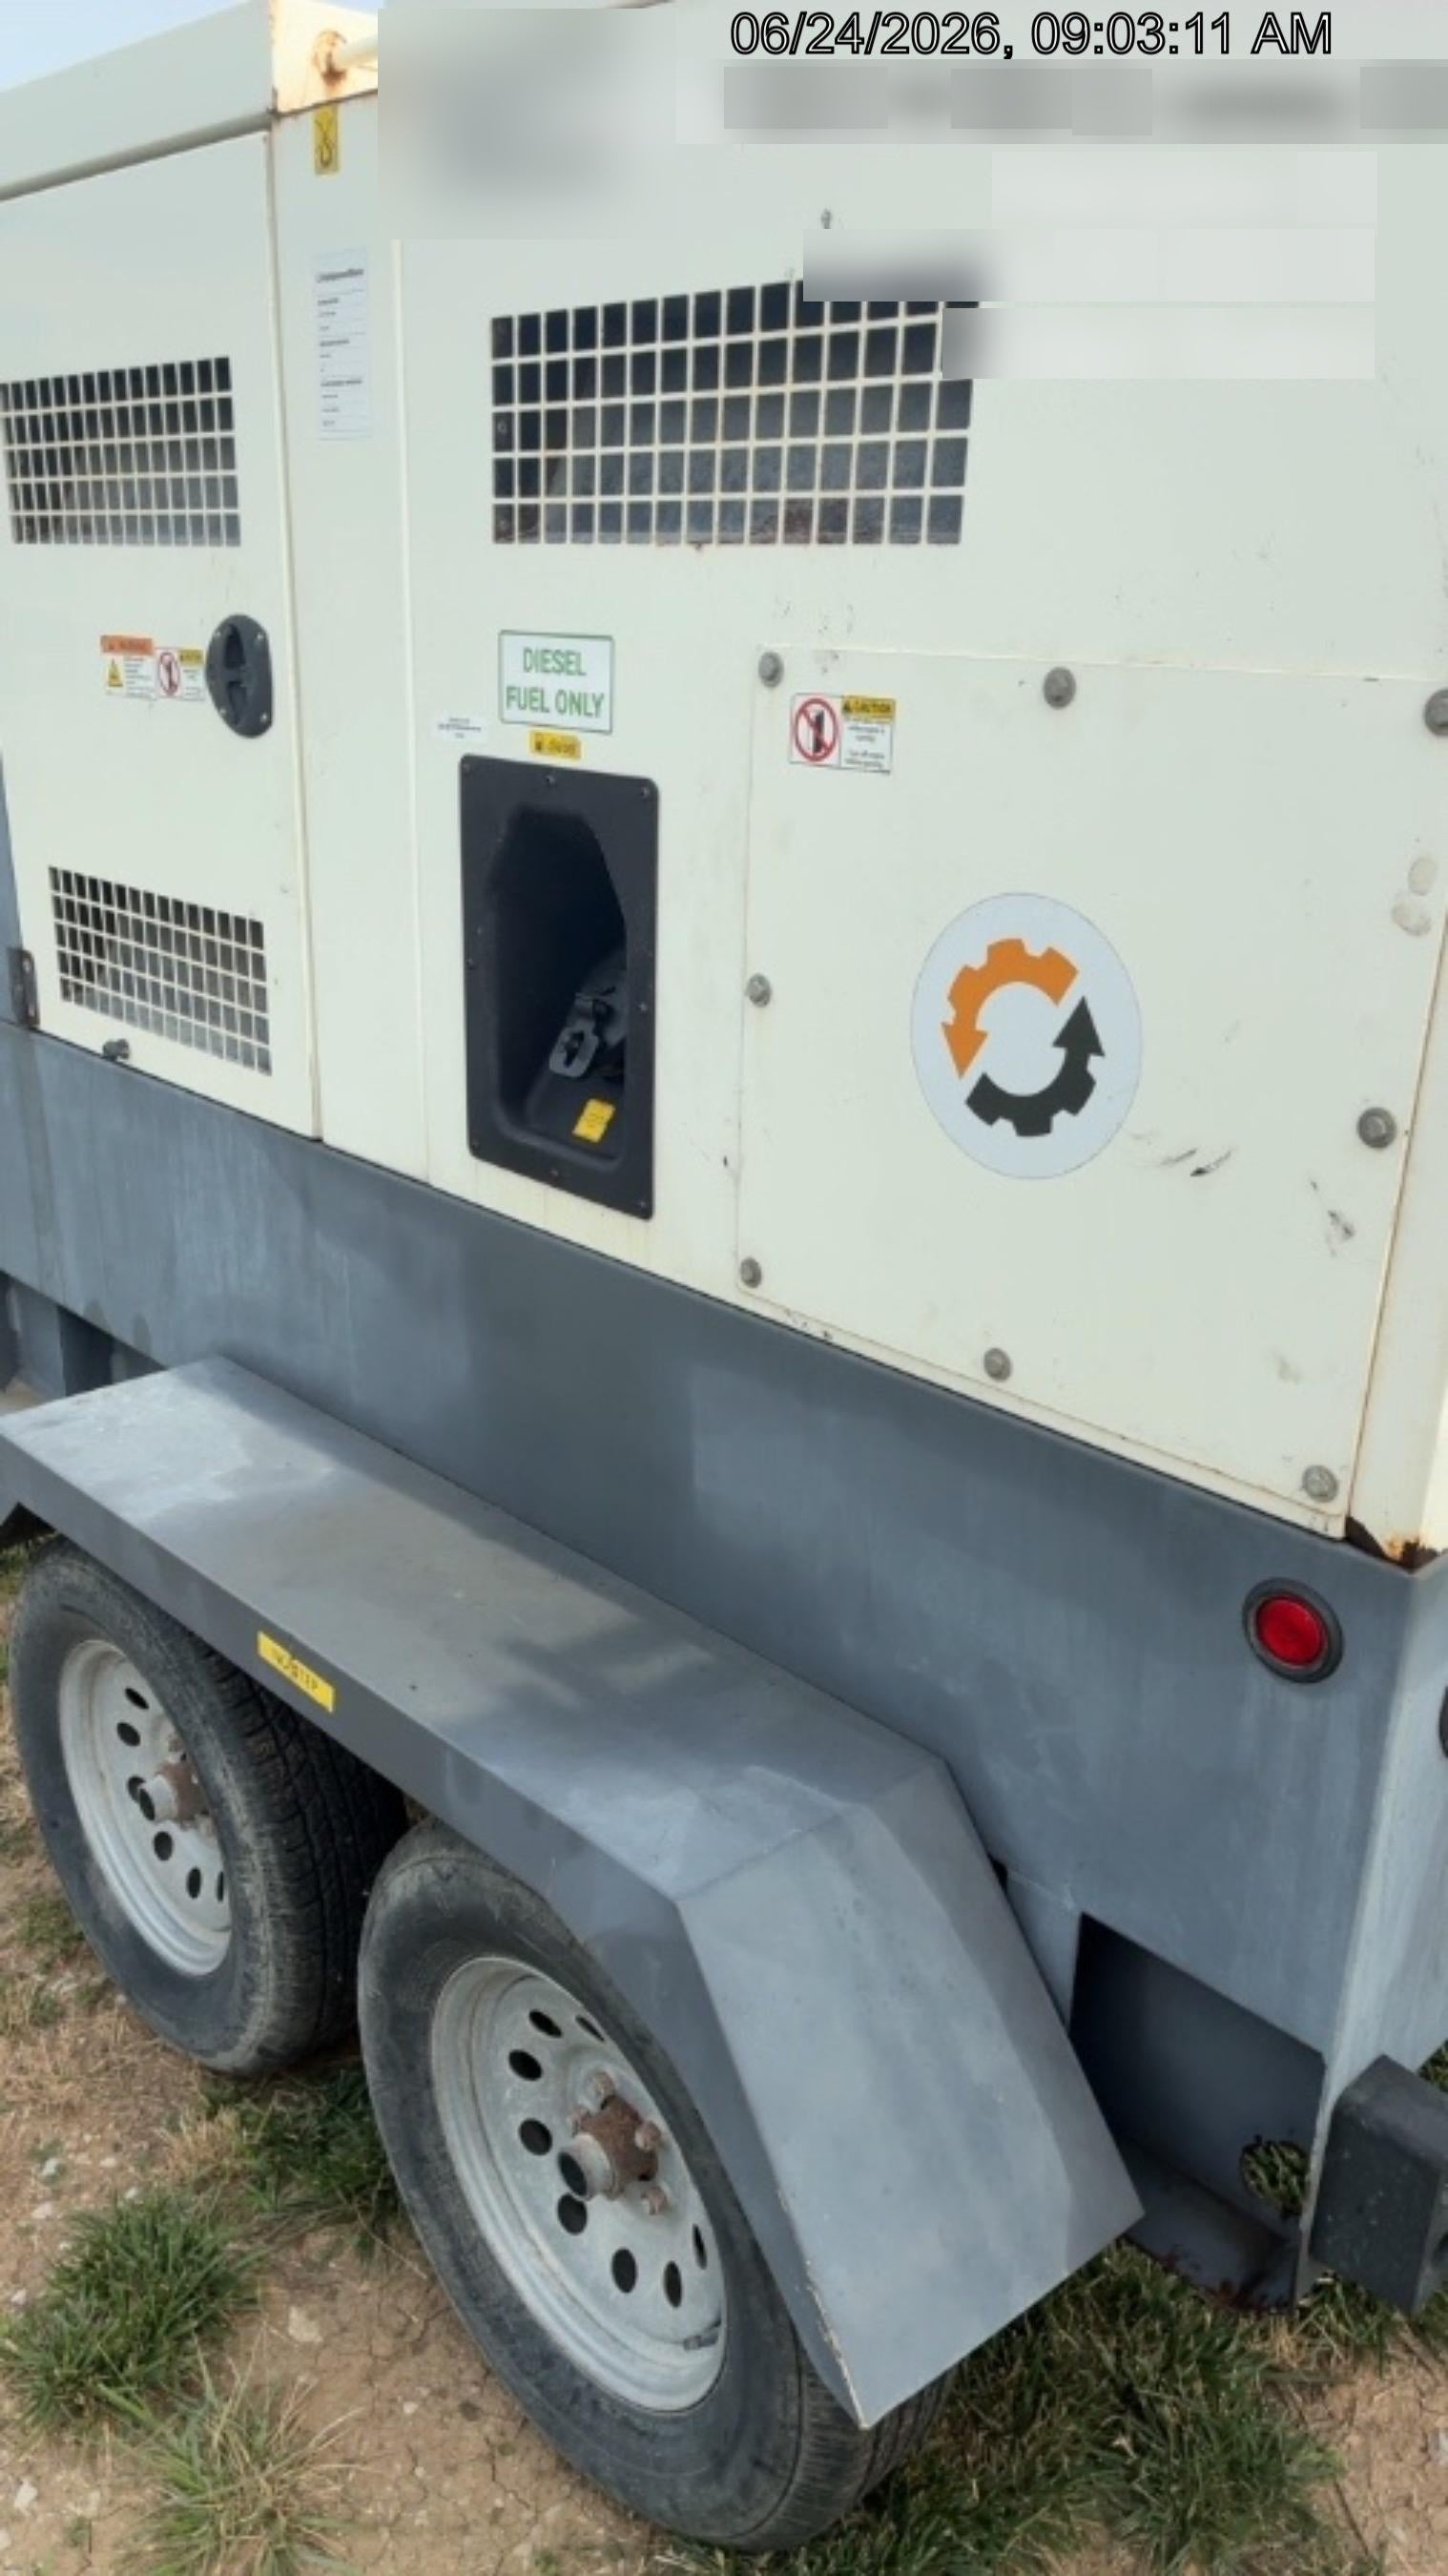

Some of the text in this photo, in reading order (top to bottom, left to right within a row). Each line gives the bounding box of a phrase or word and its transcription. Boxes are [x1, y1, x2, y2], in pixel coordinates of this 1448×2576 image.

[523, 648, 587, 676] DIESEL
[506, 686, 605, 718] FUEL ONLY
